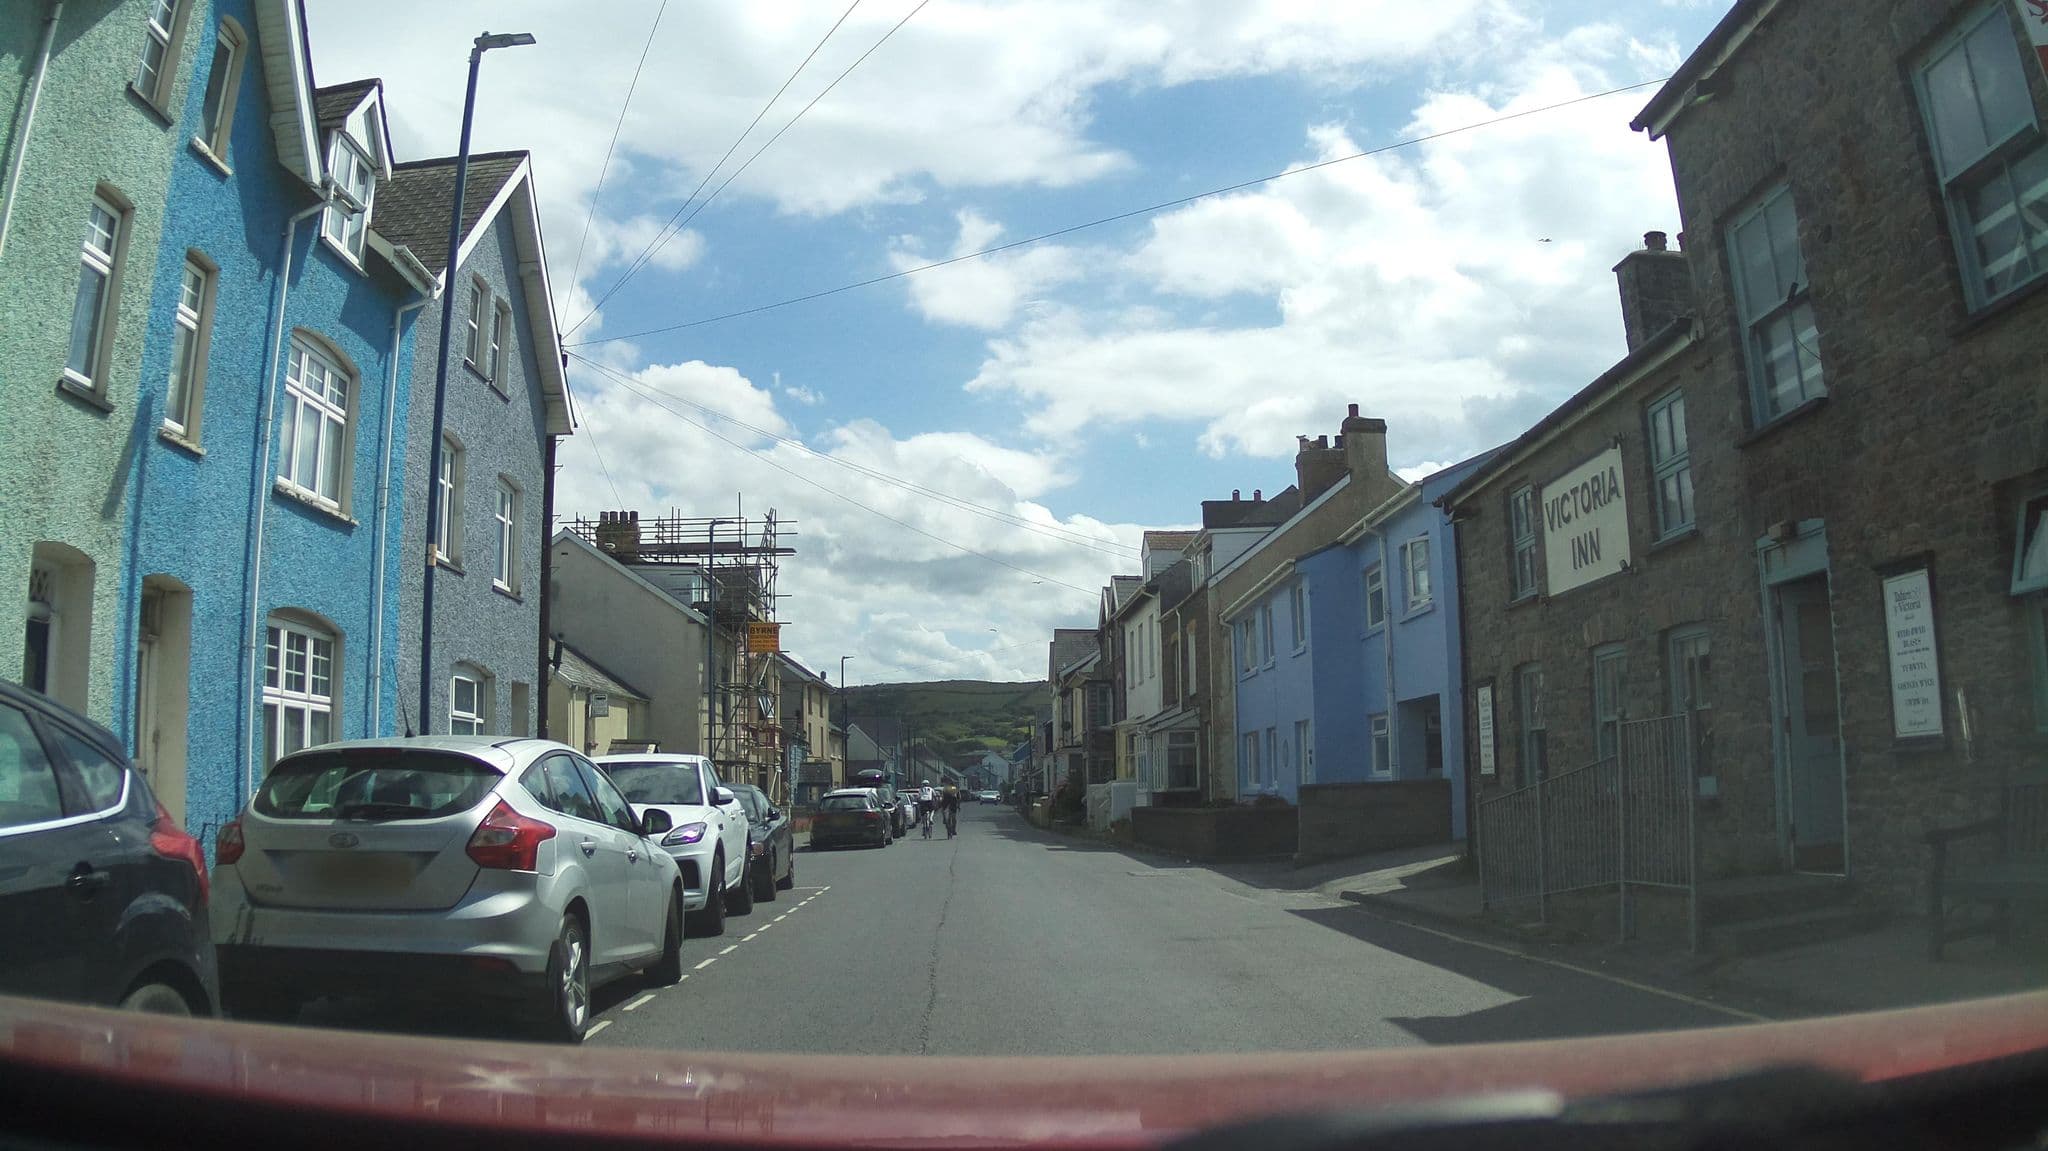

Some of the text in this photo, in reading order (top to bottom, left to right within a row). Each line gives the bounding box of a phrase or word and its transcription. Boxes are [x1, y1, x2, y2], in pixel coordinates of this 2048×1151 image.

[1545, 466, 1621, 533] VICTORIA
[1571, 527, 1601, 570] INN
[750, 626, 778, 634] BYRNE
